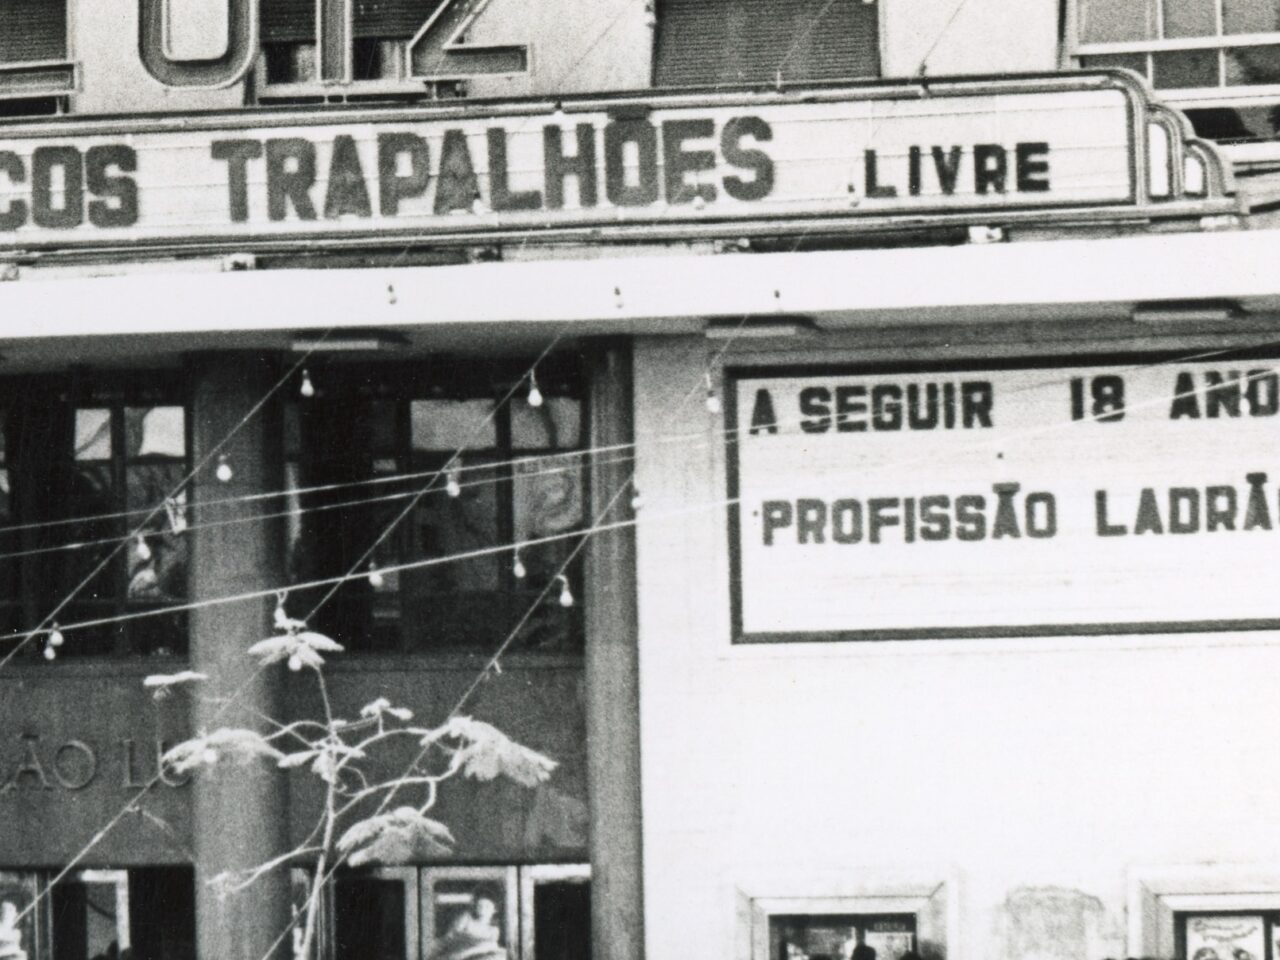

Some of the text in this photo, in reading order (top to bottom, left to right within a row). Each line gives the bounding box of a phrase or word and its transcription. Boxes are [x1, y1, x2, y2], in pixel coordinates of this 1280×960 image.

[210, 105, 774, 223] TRAPALHÕES
[864, 141, 1051, 199] LIVRE
[749, 387, 778, 435] A
[798, 380, 994, 434] SEGUIR
[1069, 373, 1126, 423] 18
[762, 472, 1280, 546] PROFISSÃO LADRÃ
